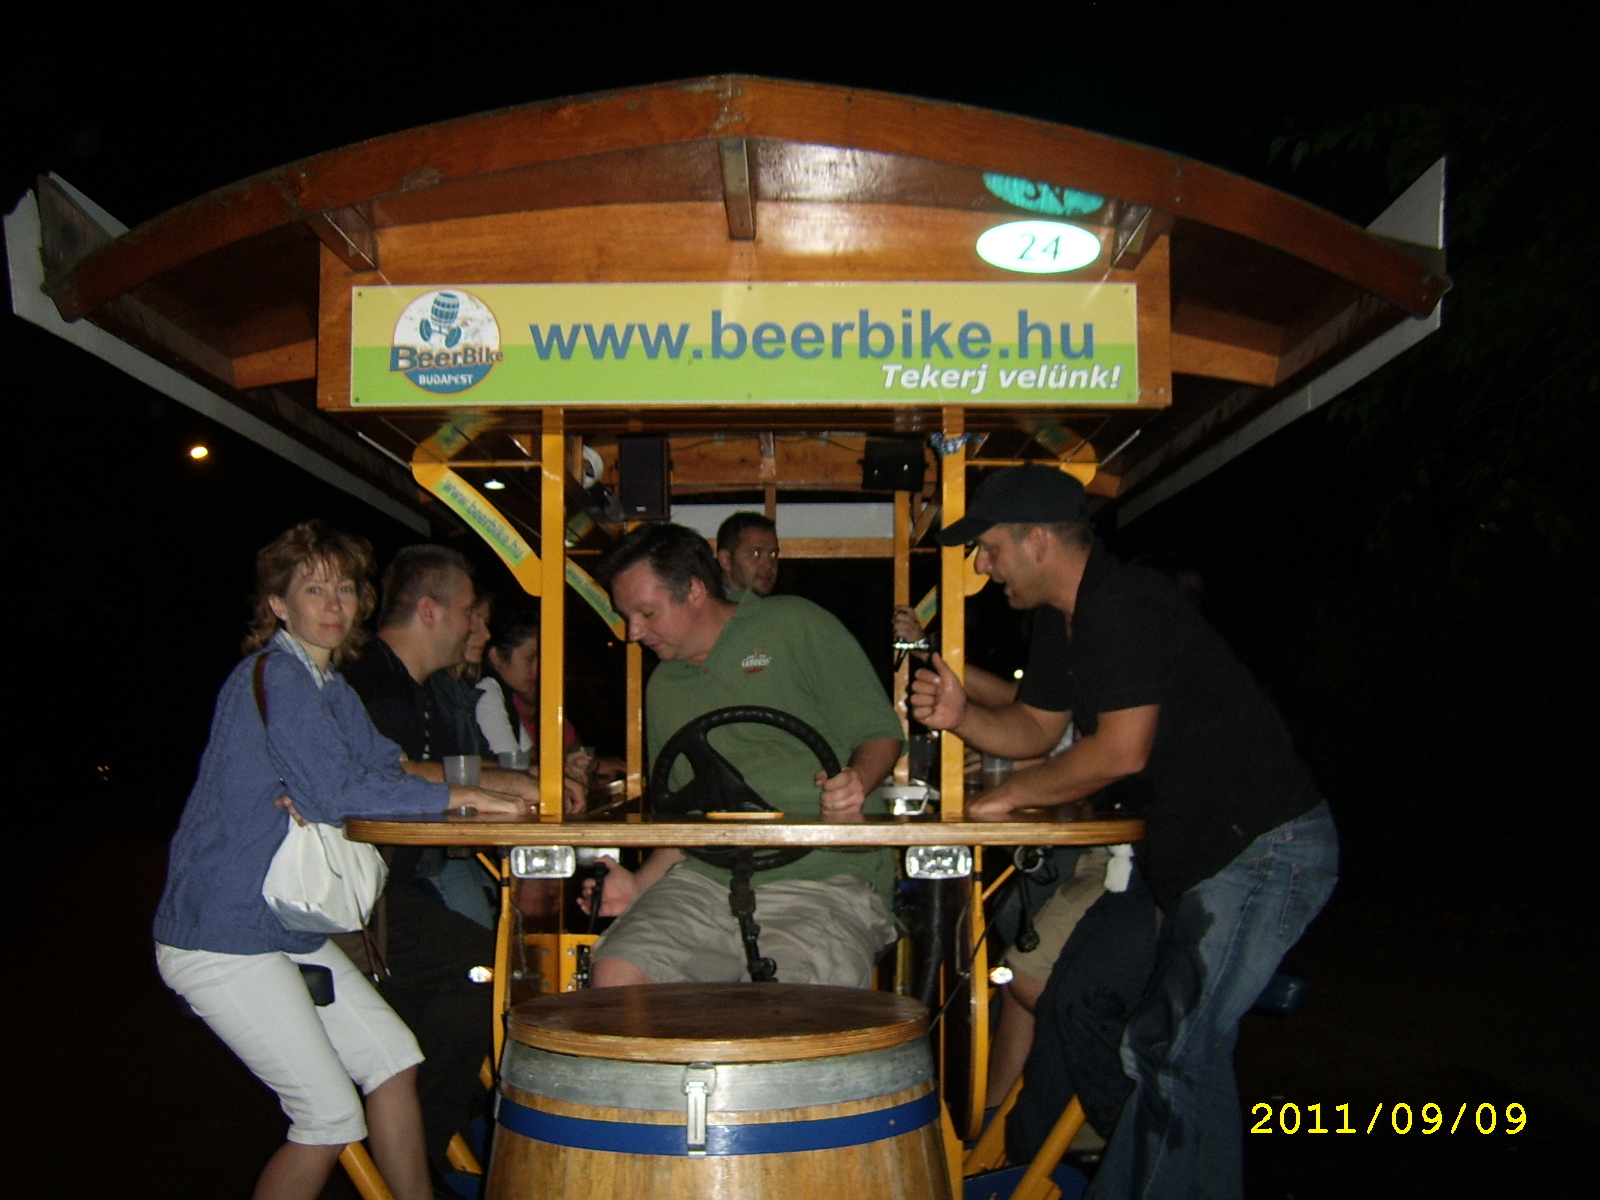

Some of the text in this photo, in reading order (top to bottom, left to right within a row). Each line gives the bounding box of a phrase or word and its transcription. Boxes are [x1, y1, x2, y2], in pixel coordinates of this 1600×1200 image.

[1018, 232, 1061, 261] 24
[529, 309, 1095, 360] www.beerbike.hu
[389, 345, 504, 372] BeerBike
[418, 373, 474, 386] BUDAPEST
[881, 363, 1122, 394] Tekerj velünk!
